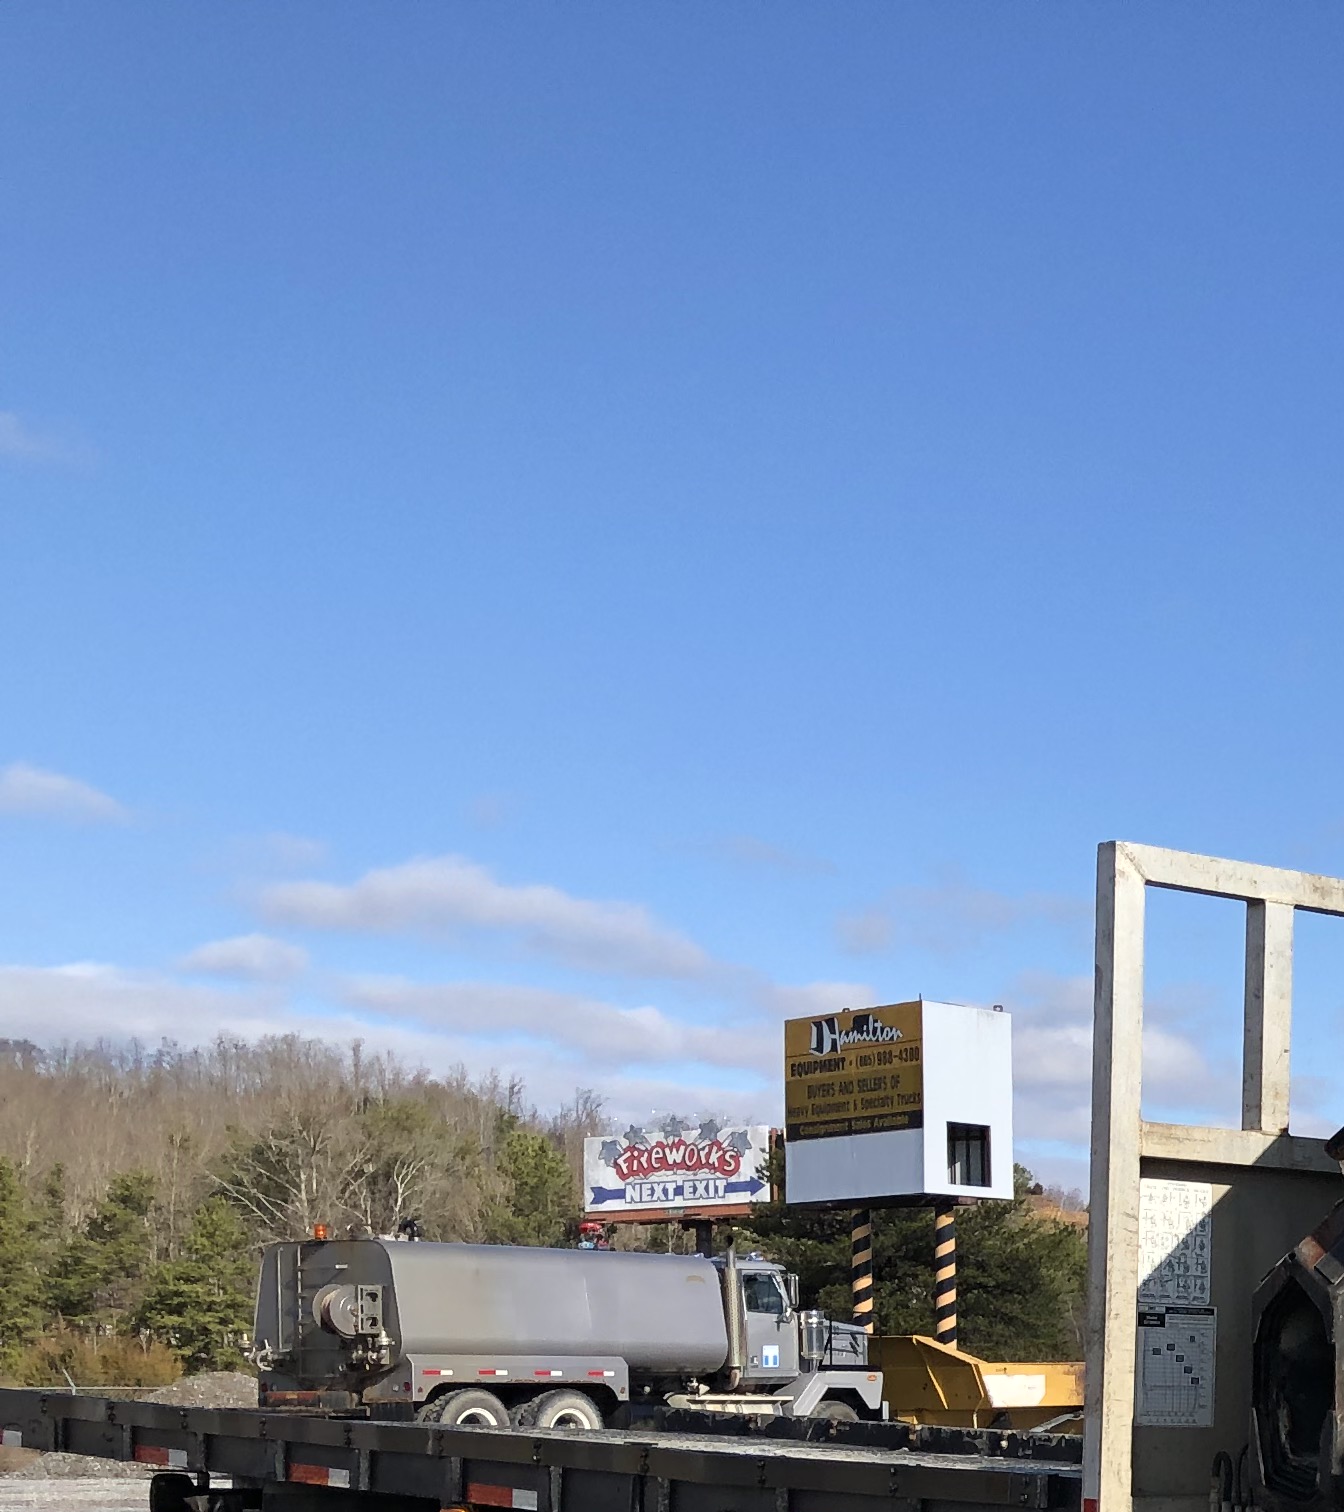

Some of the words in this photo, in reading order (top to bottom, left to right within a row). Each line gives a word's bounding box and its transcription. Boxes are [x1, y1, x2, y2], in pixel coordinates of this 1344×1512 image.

[790, 1056, 847, 1078] EQUIPMENT
[807, 1081, 836, 1100] BUYERS
[839, 1080, 855, 1096] AND
[858, 1075, 887, 1094] SELLERS
[891, 1074, 901, 1090] OF
[616, 1142, 738, 1175] Fireworks
[625, 1183, 677, 1203] NEXT
[683, 1178, 728, 1199] EXIT
